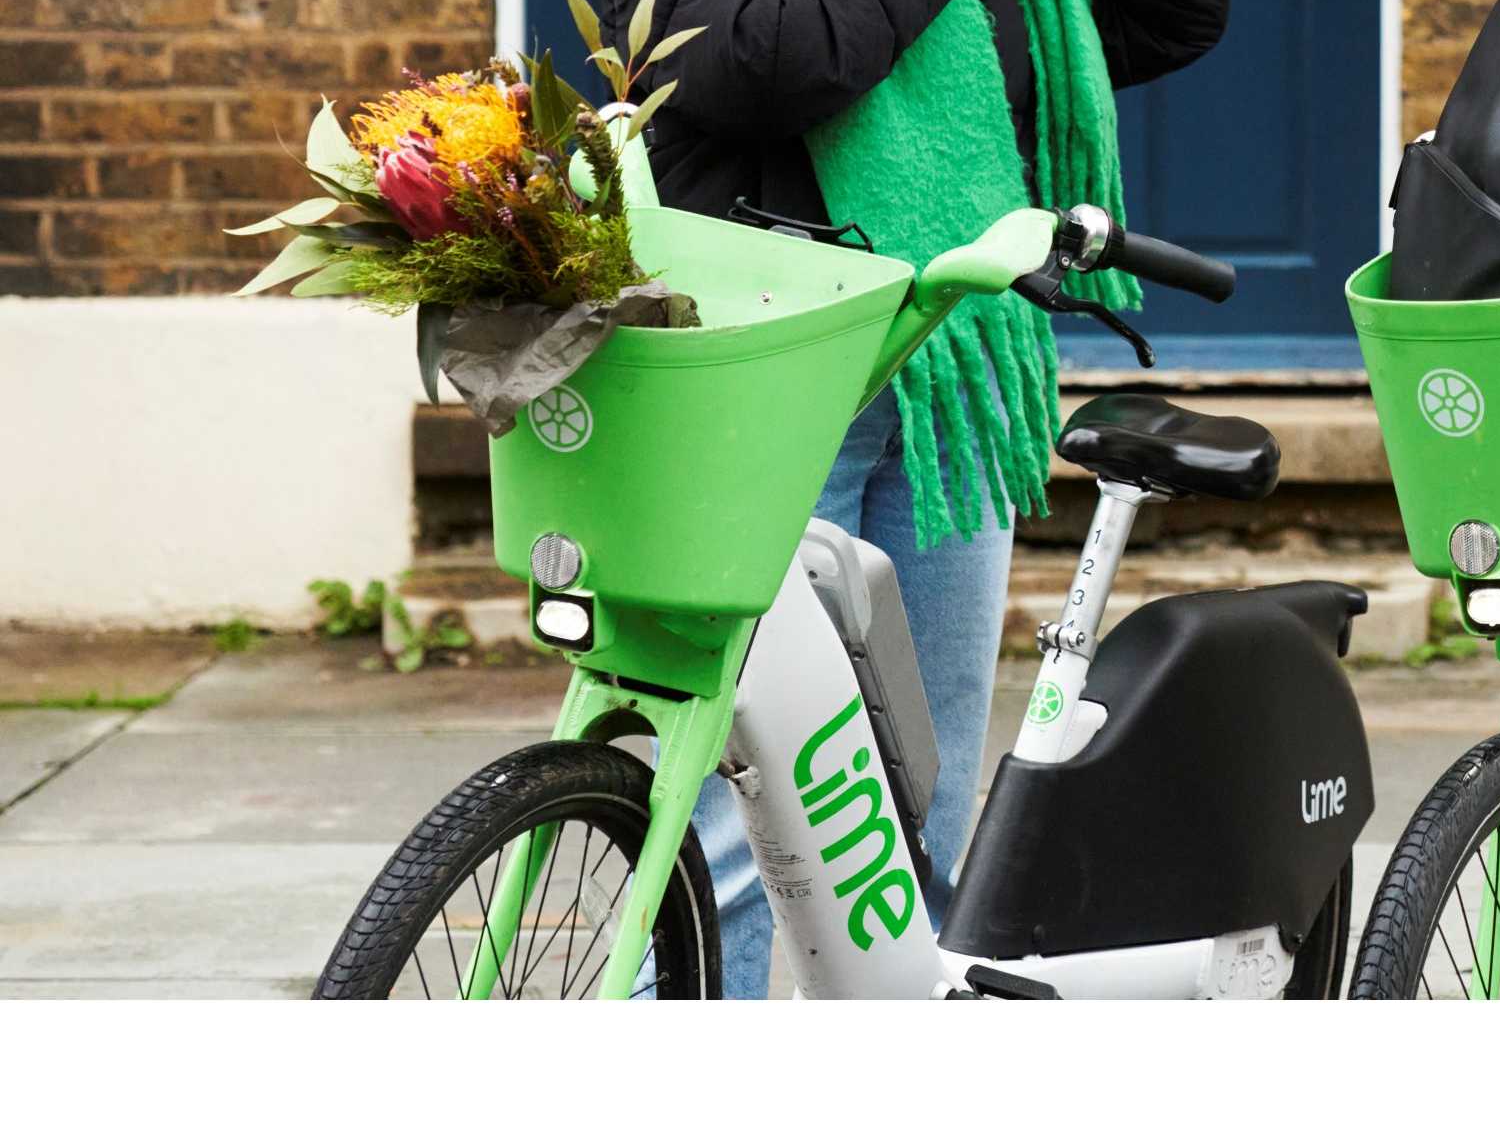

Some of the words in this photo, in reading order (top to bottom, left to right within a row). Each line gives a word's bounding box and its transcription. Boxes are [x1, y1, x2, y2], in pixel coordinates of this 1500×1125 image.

[1095, 530, 1101, 544] 1
[1082, 558, 1094, 575] 2
[1072, 589, 1085, 605] 3
[1301, 776, 1347, 824] Lime
[793, 693, 915, 952] Lime
